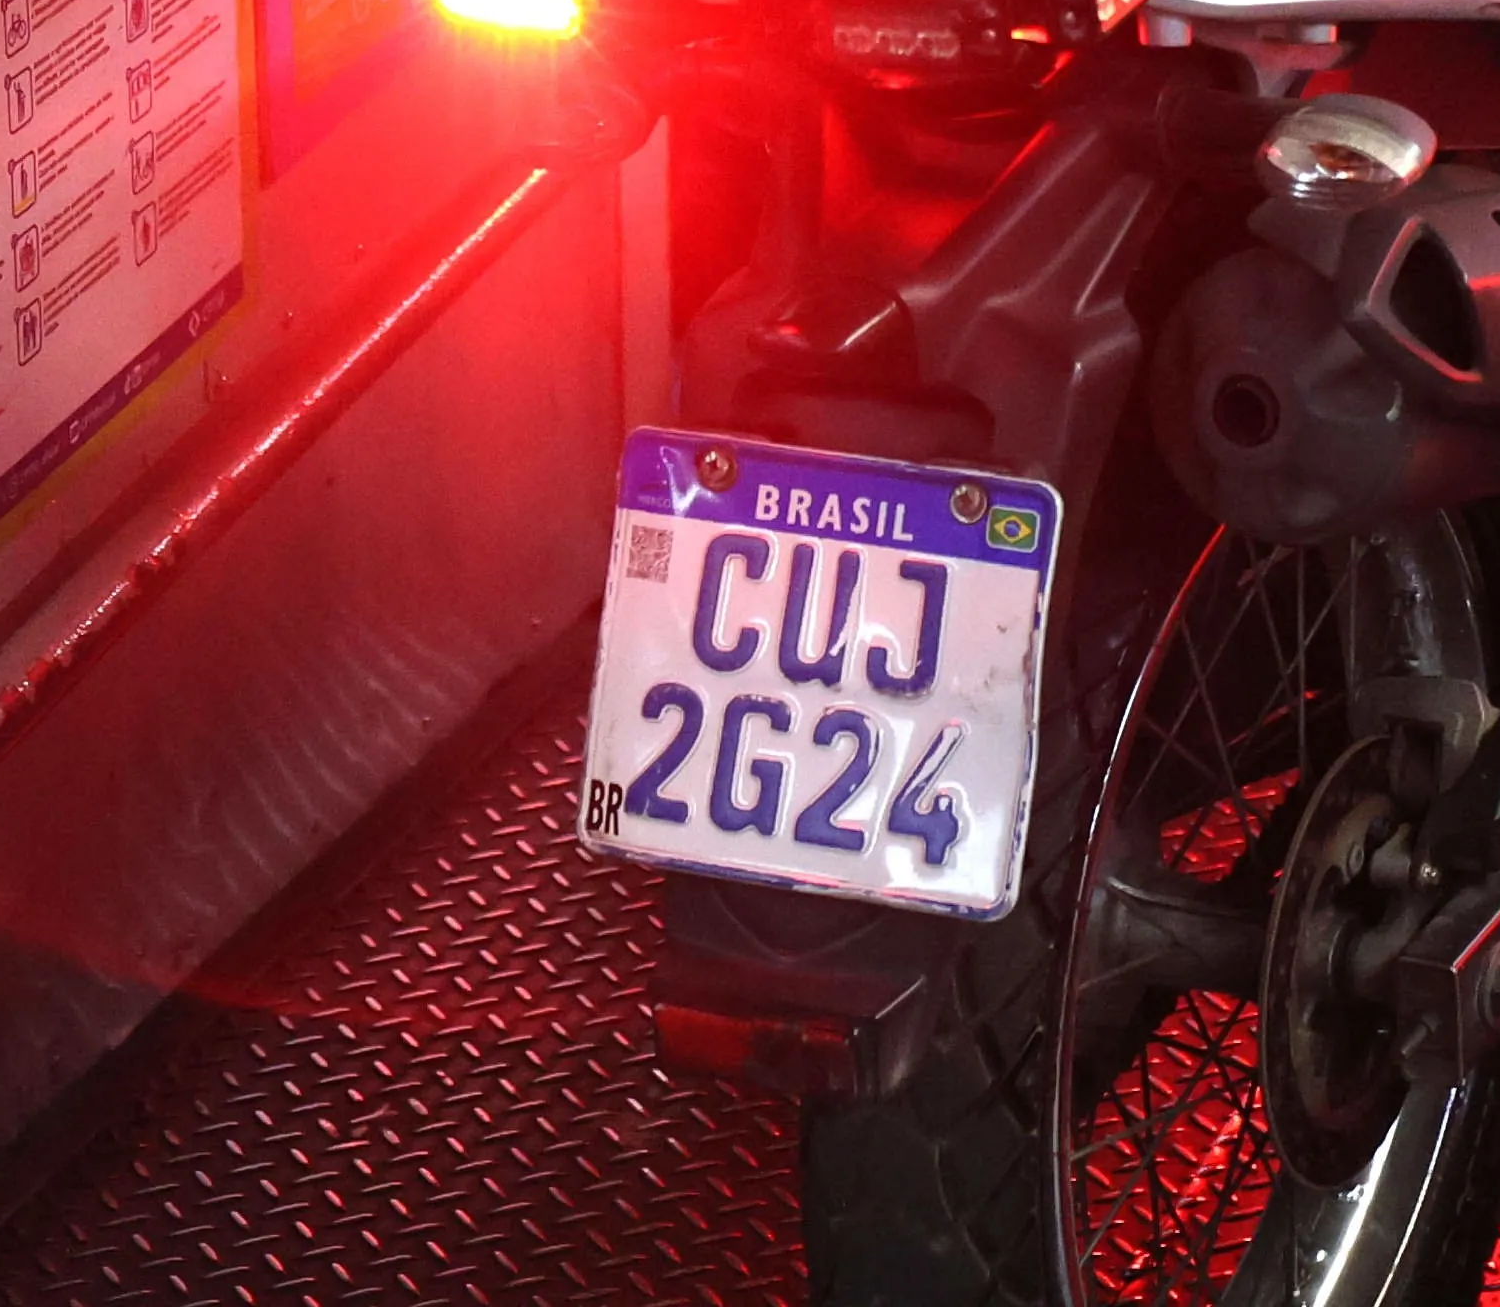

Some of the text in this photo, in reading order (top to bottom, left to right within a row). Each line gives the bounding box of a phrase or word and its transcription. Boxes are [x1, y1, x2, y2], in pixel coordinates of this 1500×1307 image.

[754, 483, 915, 543] BRASIL
[692, 533, 950, 699] CUJ
[586, 778, 623, 837] BR
[623, 681, 964, 866] 2G24
